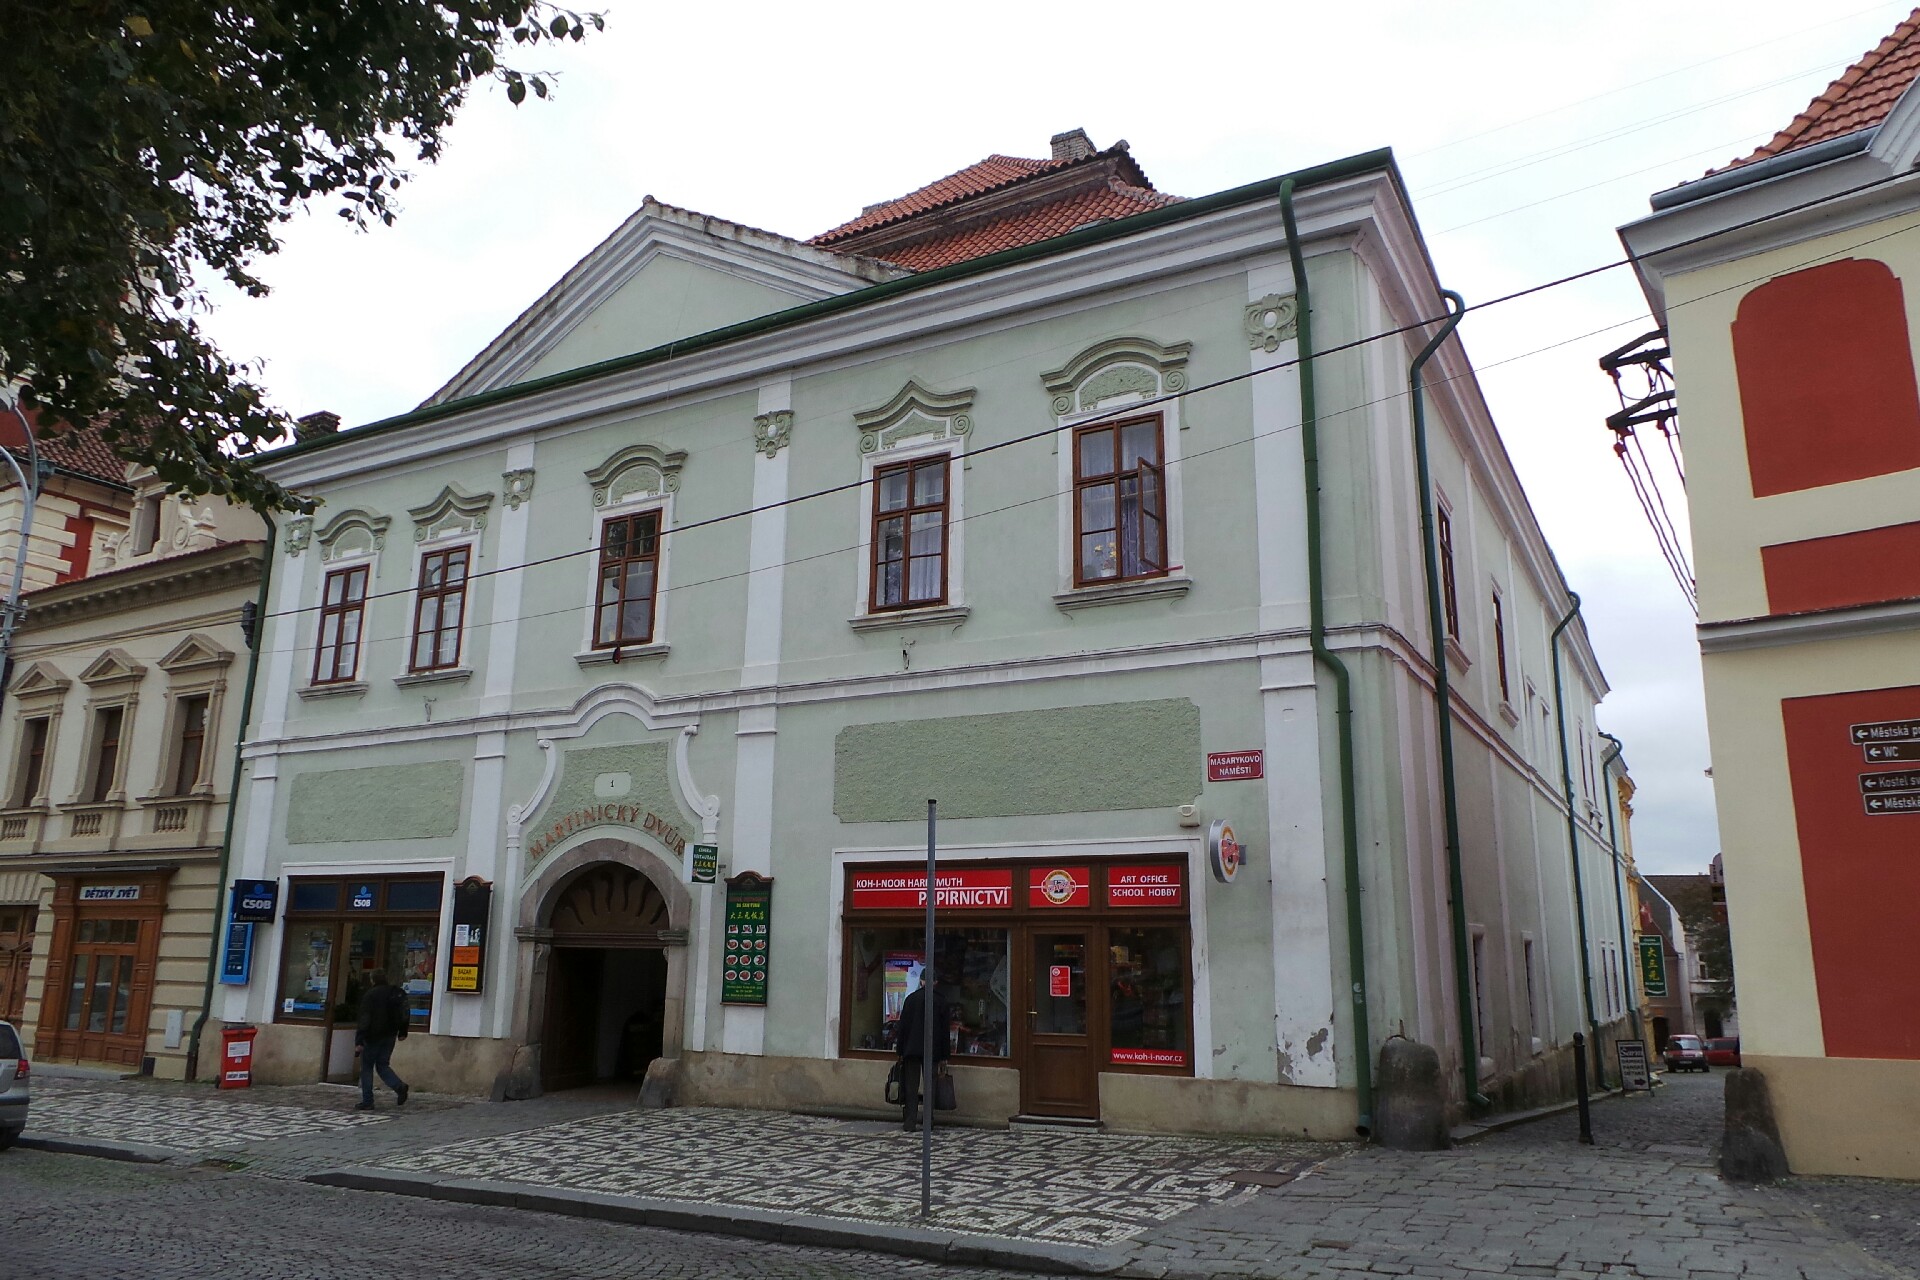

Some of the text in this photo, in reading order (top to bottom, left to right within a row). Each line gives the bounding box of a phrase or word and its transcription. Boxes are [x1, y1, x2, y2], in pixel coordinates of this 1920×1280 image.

[1870, 725, 1909, 738] Městská
[1883, 746, 1899, 757] WC
[1210, 755, 1260, 766] MASARYKOVO
[1219, 765, 1252, 776] NÁMĚSTÍ
[610, 779, 615, 788] 1
[1879, 776, 1909, 788] Kostel
[529, 802, 686, 860] MARTINICKÝ DVŮR
[856, 879, 906, 888] KOH-I-NOOR
[1120, 875, 1168, 884] ART OFFICE
[84, 886, 138, 898] DĚTSKÝ SVĚT
[918, 886, 1008, 906] PPÍRNICTVÍ
[1112, 888, 1177, 897] SCHOOL HOBBY
[242, 898, 272, 909] ČSOB
[353, 898, 371, 907] ČSOB
[1113, 1051, 1183, 1062] www.koh-i-noor.cz
